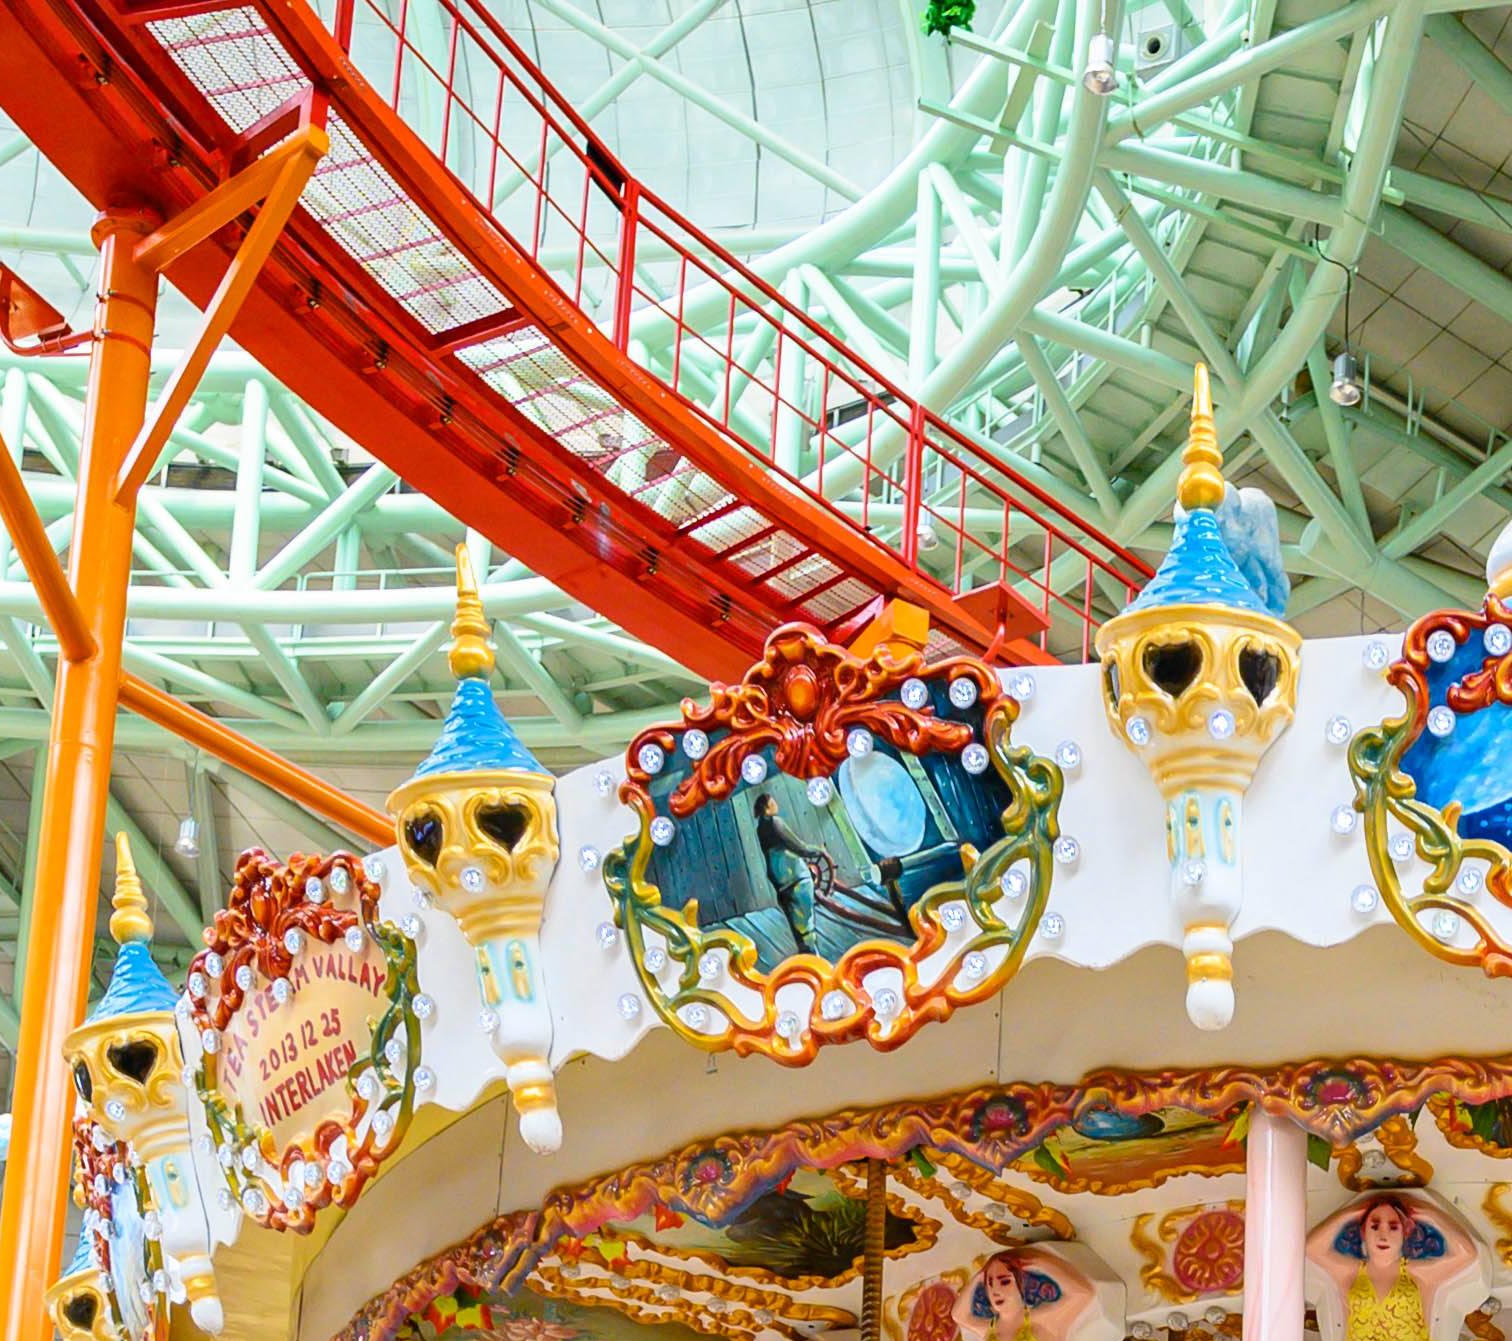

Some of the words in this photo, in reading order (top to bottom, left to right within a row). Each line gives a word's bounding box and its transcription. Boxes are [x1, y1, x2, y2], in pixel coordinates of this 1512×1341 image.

[223, 1033, 248, 1093] TEA
[247, 964, 310, 1037] STEM
[312, 953, 386, 998] VALLAY
[259, 1033, 298, 1081] 2013
[300, 1020, 318, 1050] 12
[320, 1008, 342, 1037] 25
[259, 1040, 357, 1128] INTERLAKEN
